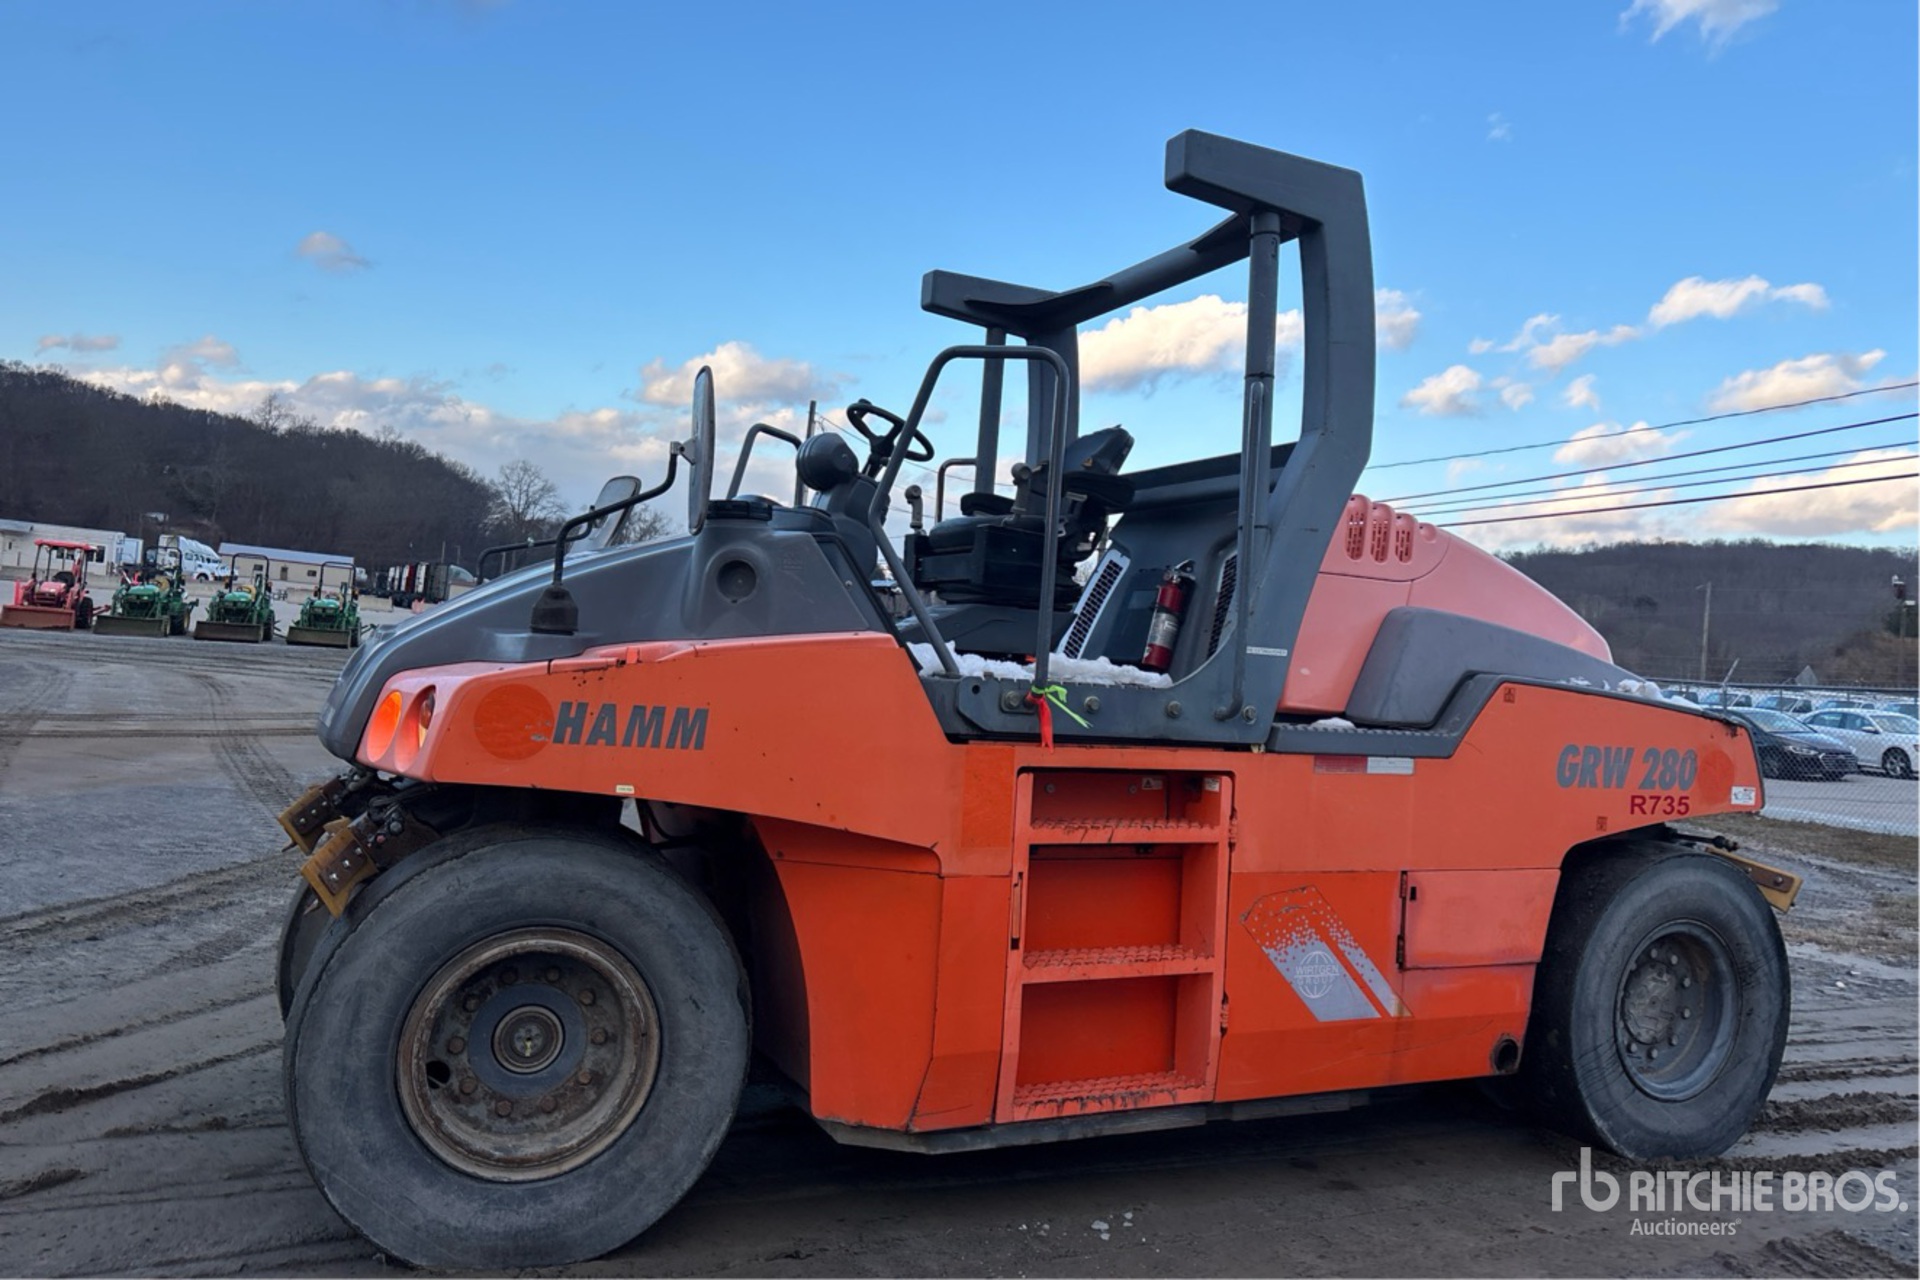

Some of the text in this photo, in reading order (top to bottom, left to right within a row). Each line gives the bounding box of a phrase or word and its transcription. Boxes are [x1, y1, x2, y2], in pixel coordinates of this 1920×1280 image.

[552, 701, 709, 750] HAMM
[1556, 744, 1698, 791] GRW 280
[1630, 795, 1690, 815] R735
[1295, 964, 1339, 976] WIRTGEN
